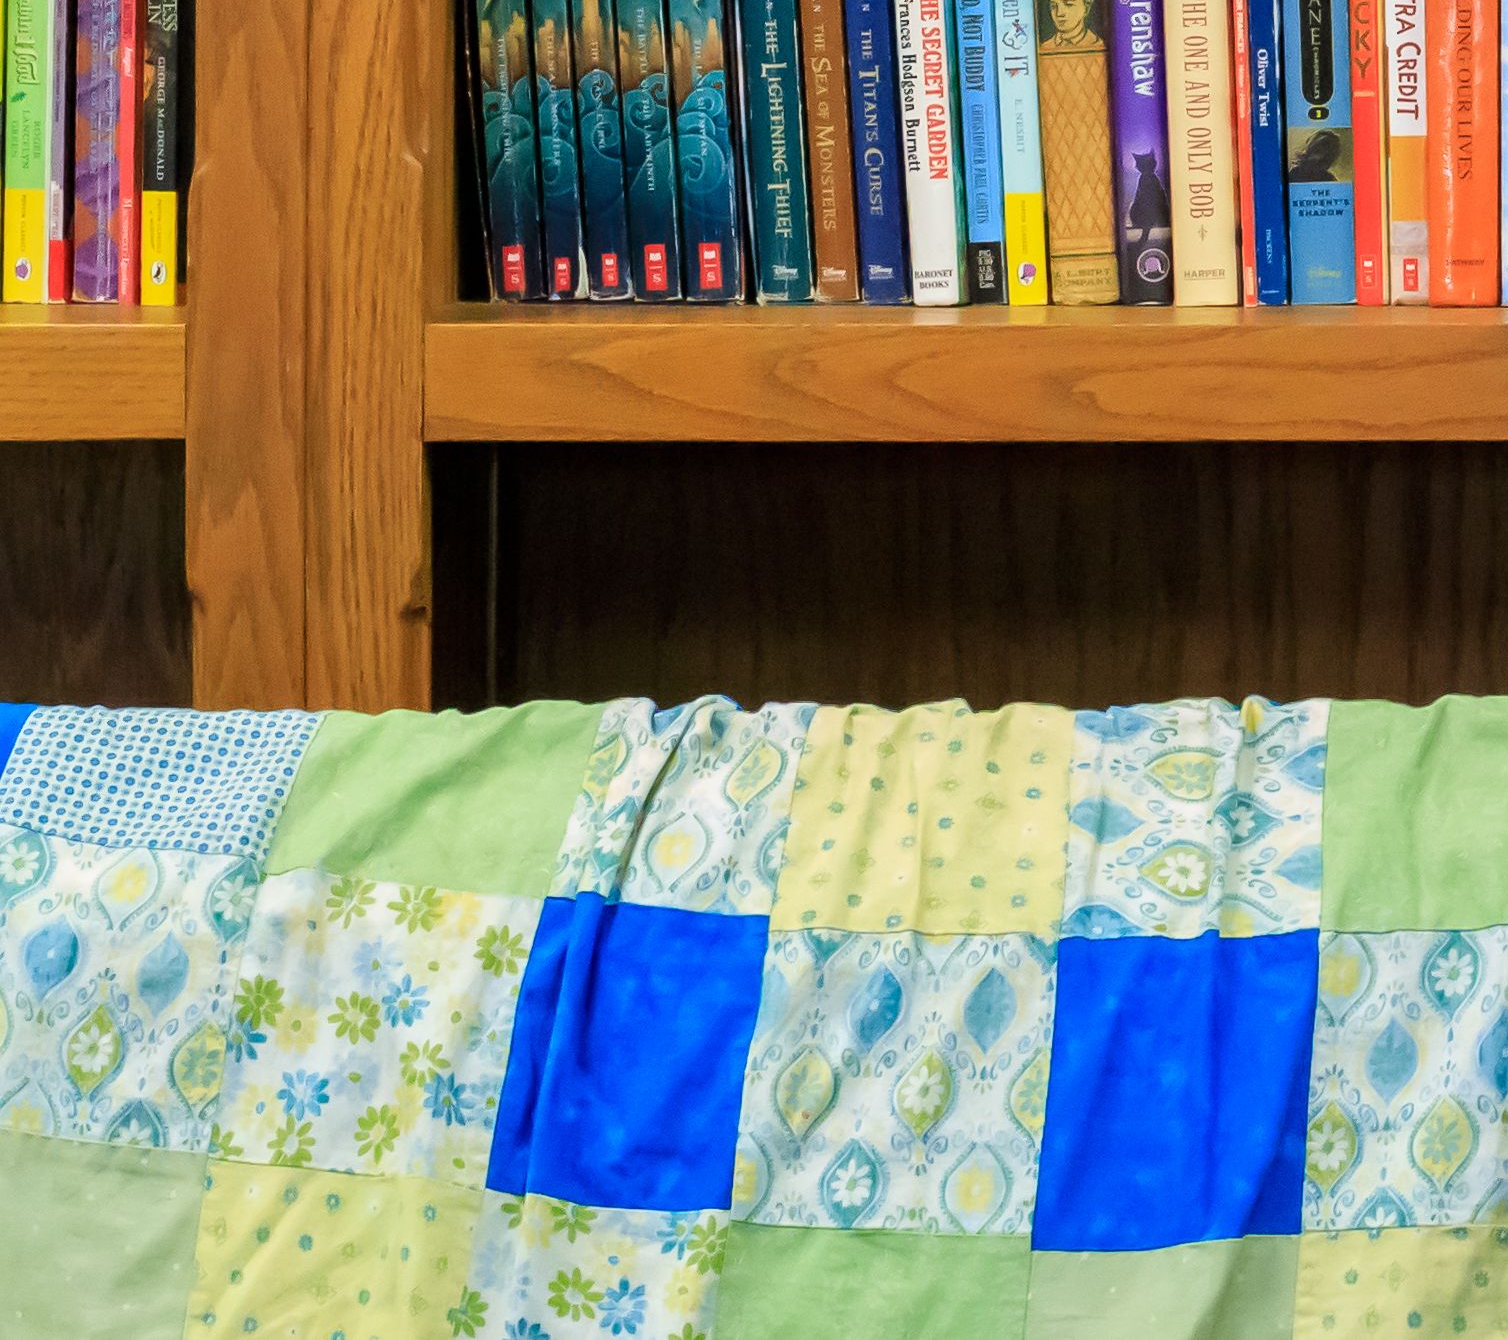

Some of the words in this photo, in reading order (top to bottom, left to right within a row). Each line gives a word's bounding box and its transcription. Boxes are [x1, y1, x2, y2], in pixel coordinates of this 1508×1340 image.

[921, 27, 944, 98] SECRET
[1183, 36, 1210, 72] ONE
[1396, 41, 1422, 121] CREDIT
[898, 54, 919, 112] Hodgson
[1184, 82, 1212, 117] AND
[903, 118, 921, 173] Burnett
[926, 103, 948, 180] GARDEN
[1187, 128, 1214, 174] ONLY
[1189, 182, 1216, 220] BOB
